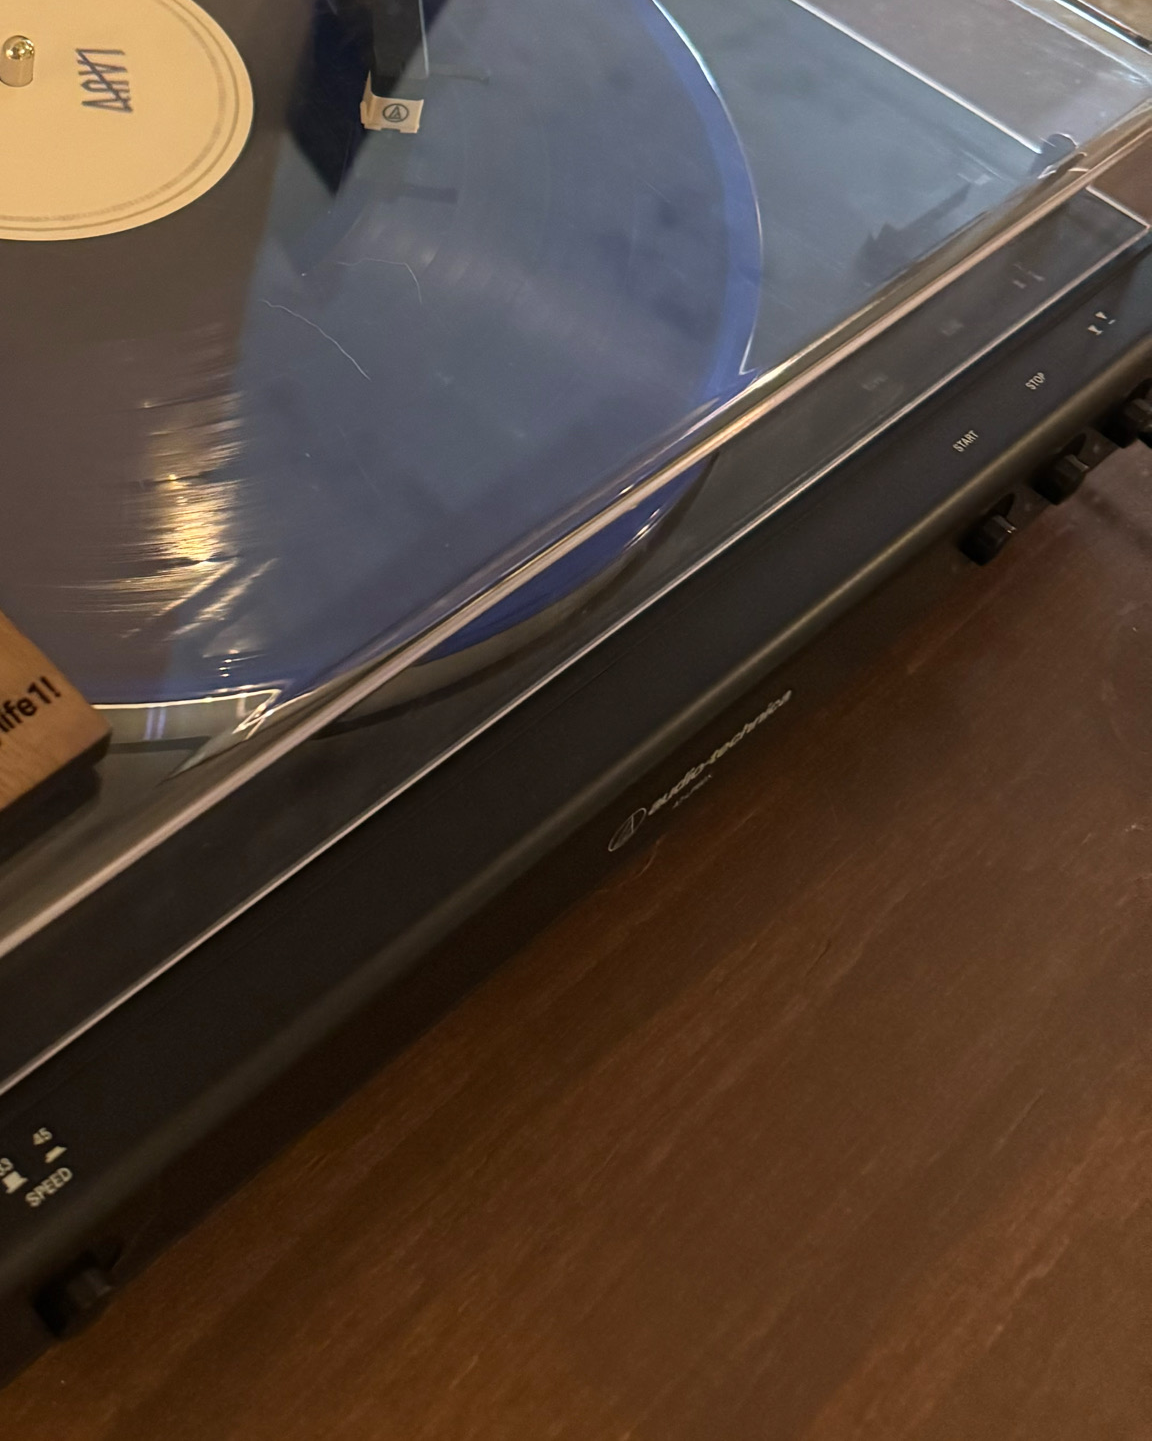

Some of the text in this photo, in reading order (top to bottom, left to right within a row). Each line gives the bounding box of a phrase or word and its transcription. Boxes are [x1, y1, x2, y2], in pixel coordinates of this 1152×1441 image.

[1025, 371, 1046, 392] STOP
[952, 429, 979, 453] START
[32, 1127, 53, 1146] 45
[25, 1167, 73, 1207] SPEED
